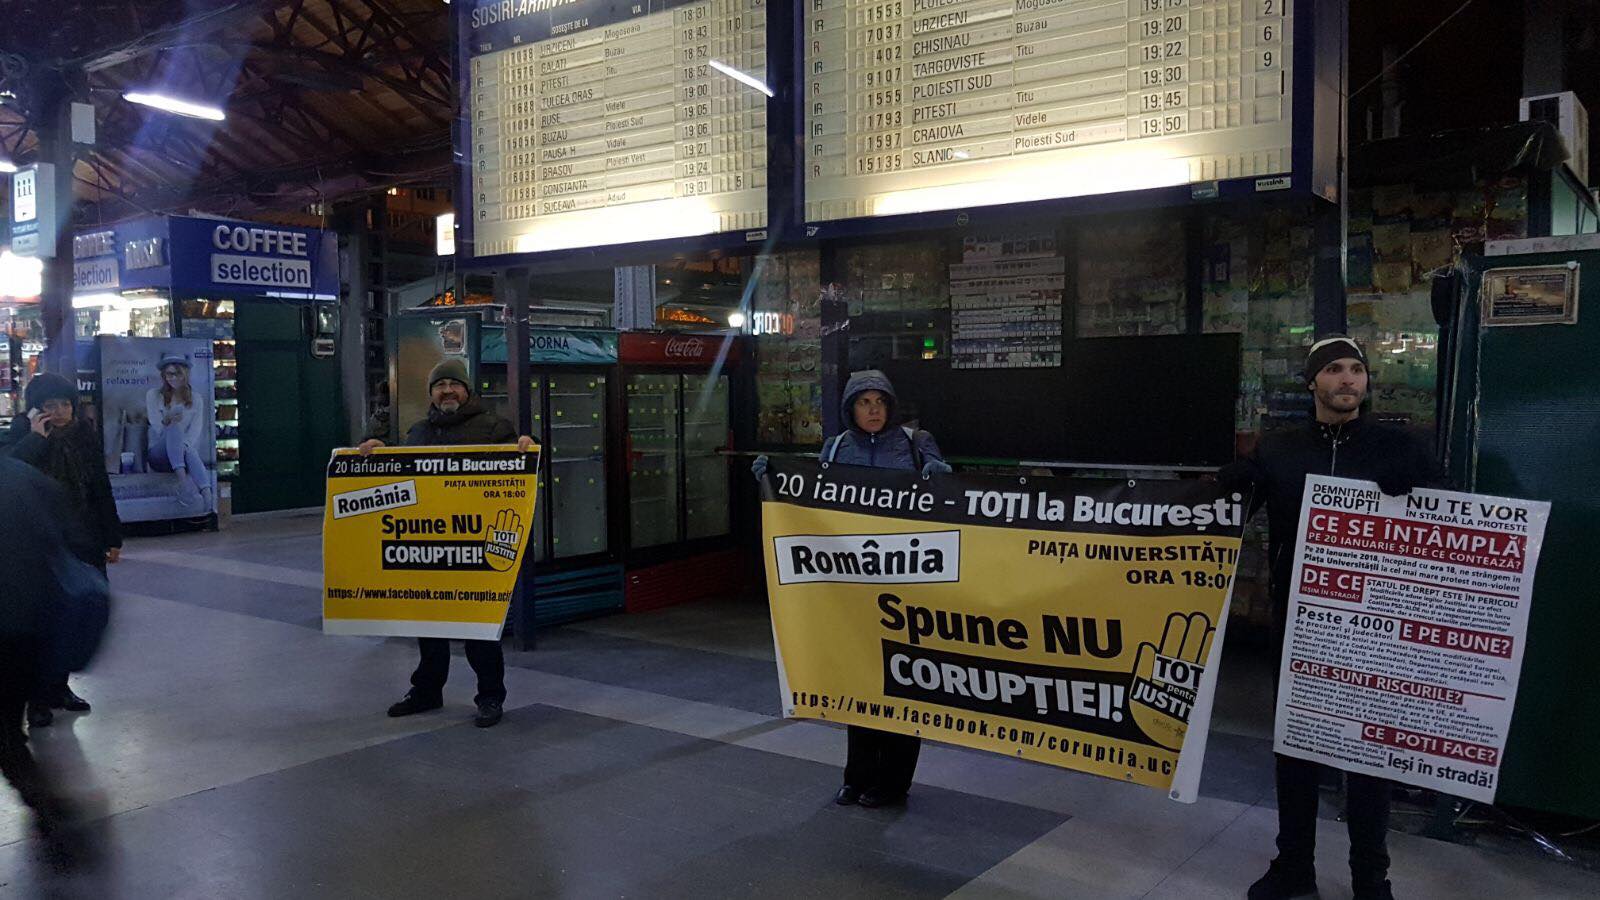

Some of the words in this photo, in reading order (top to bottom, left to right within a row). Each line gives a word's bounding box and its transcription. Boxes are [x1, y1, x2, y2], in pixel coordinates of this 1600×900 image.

[683, 6, 706, 22] 18:31
[867, 3, 902, 21] 1553
[868, 24, 902, 42] 7037
[913, 10, 968, 33] URZICENI
[541, 59, 567, 74] GALATI
[684, 26, 708, 41] 18:43
[867, 68, 902, 86] 9107
[914, 52, 986, 75] TARGOVISTE
[1016, 45, 1034, 58] Titu
[1144, 16, 1182, 36] 19:20
[1264, 0, 1272, 15] 2
[876, 46, 902, 62] 402
[913, 33, 970, 55] CHISINAU
[1016, 20, 1048, 34] Buzau
[541, 76, 568, 92] PITESTI
[684, 46, 708, 61] 18:52
[684, 64, 708, 80] 18:52
[868, 90, 902, 108] 1555
[913, 80, 965, 99] PLOIESTI
[968, 74, 992, 90] SUD
[1144, 42, 1182, 60] 19:22
[1264, 25, 1272, 41] 6
[541, 112, 561, 126] RUSE
[684, 84, 708, 100] 19:00
[868, 110, 902, 128] 1793
[913, 102, 957, 121] PITESTI
[1016, 91, 1034, 104] Titu
[1144, 66, 1182, 86] 19:30
[1264, 51, 1272, 67] 9
[542, 131, 568, 145] BUZAU
[684, 104, 708, 118] 19:05
[684, 124, 708, 138] 19:06
[868, 132, 902, 150] 1597
[913, 124, 964, 142] CRAIOVA
[1016, 112, 1047, 127] Videle
[1143, 90, 1182, 110] 19:45
[858, 154, 902, 172] 15135
[913, 148, 954, 165] SLANIC
[1015, 134, 1052, 148] Ploiesti
[1054, 132, 1075, 144] Sud
[1143, 116, 1181, 134] 19:50
[542, 164, 574, 179] BRASOV
[685, 142, 708, 156] 19:21
[542, 180, 588, 197] CONSTANTA
[685, 162, 708, 176] 19:24
[543, 199, 576, 214] SUCEAVA
[685, 180, 708, 196] 19:31
[212, 225, 308, 257] COFFEE
[74, 261, 112, 287] election
[217, 259, 309, 284] selection
[335, 461, 348, 474] 20
[350, 458, 402, 474] ianuarie
[414, 459, 444, 475] TOȚI
[447, 458, 460, 472] la
[338, 486, 411, 514] România
[444, 480, 467, 490] PIAȚA
[468, 478, 526, 490] UNIVERSITĂȚII
[503, 490, 526, 498] 18:00
[1314, 484, 1380, 500] DEMNITARII
[776, 472, 804, 498] 20
[814, 474, 934, 512] ianuarie
[964, 490, 1030, 523] TOȚI
[1037, 492, 1065, 522] la
[1072, 492, 1242, 532] București
[1312, 493, 1380, 514] CORUPȚI
[1406, 495, 1439, 512] NU
[1446, 500, 1472, 516] TE
[1480, 503, 1528, 524] VOR
[382, 514, 446, 540] Spune
[452, 514, 482, 534] NU
[1312, 514, 1340, 533] CE
[1348, 519, 1375, 538] SE
[1384, 518, 1520, 558] ÎNTÂMPLĂ
[1406, 509, 1416, 518] ÎN
[1419, 512, 1458, 524] STRADĂ
[1462, 518, 1474, 526] LA
[1478, 520, 1528, 533] PROTESTE
[384, 546, 483, 566] CORUPȚIEI!
[790, 538, 944, 576] România
[1028, 540, 1079, 564] PIAȚA
[1308, 532, 1320, 540] PE
[1324, 534, 1337, 544] 20
[1340, 537, 1395, 552] IANUARIE
[1399, 544, 1408, 554] ȘI
[1413, 546, 1428, 556] DE
[1432, 550, 1445, 559] CE
[1449, 552, 1522, 570] CONTEAZĂ?
[1326, 548, 1358, 560] ianuarie
[1382, 556, 1417, 568] începând
[1430, 564, 1444, 572] ora
[1446, 566, 1457, 575] 18,
[1460, 568, 1470, 576] ne
[1472, 570, 1510, 583] strângem
[1512, 575, 1521, 584] în
[1126, 569, 1175, 585] ORA
[1303, 568, 1330, 586] DE
[1336, 574, 1362, 591] CE
[1390, 566, 1400, 574] cel
[1402, 568, 1417, 577] mai
[1418, 572, 1439, 580] mare
[1440, 574, 1470, 586] protest
[1472, 580, 1520, 592] non-violent
[1366, 580, 1398, 590] STATUL
[1400, 584, 1410, 592] DE
[1412, 586, 1440, 596] DREPT
[1442, 590, 1463, 600] ESTE
[1465, 592, 1475, 602] ÎN
[1478, 596, 1518, 608] PERICOL!
[877, 592, 1029, 650] Spune
[1042, 614, 1123, 659] NU
[1297, 605, 1342, 624] Peste
[1349, 614, 1394, 633] 4000
[1306, 622, 1342, 632] procurori
[1352, 628, 1392, 640] judecători
[1402, 623, 1414, 638] E
[1418, 626, 1441, 644] PE
[1446, 630, 1510, 655] BUNE?
[890, 652, 1125, 724] CORUPȚIEI!
[1291, 660, 1329, 678] CARE
[1332, 668, 1372, 686] SUNT
[1376, 676, 1462, 704] RISCURILE?
[792, 690, 1178, 775] ttps://www.facebook.com/coruptia.uc
[1364, 726, 1386, 740] CE
[1395, 732, 1436, 752] POȚI
[1442, 741, 1496, 762] FACE?
[1388, 752, 1414, 774] Ieși
[1417, 758, 1433, 776] în
[1436, 766, 1494, 789] stradă!
